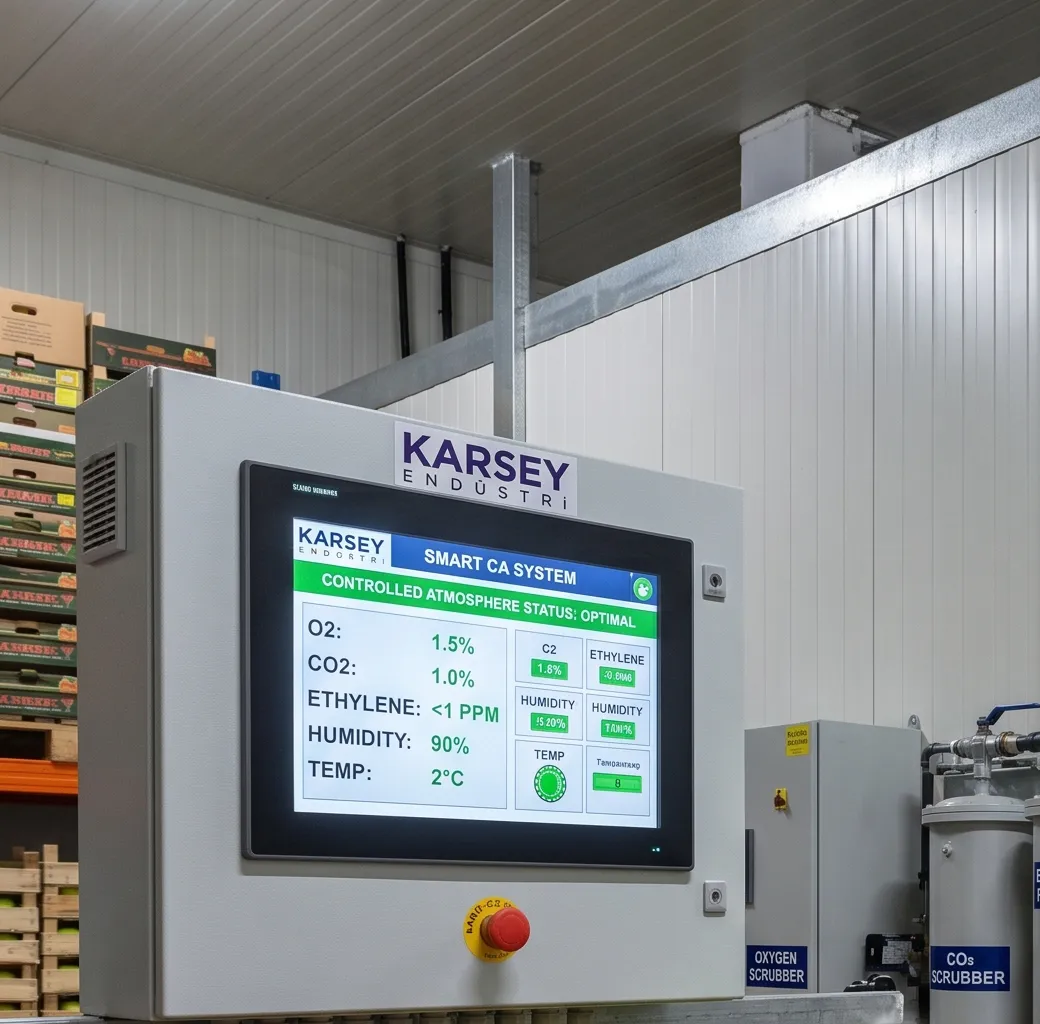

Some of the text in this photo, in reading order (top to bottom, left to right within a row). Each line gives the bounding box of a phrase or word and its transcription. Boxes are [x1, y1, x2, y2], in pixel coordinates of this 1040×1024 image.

[403, 431, 570, 492] KARSEY
[298, 526, 385, 555] KARSEY
[424, 548, 577, 585] SMART CA SYSTEM
[321, 572, 636, 628] CONTROLLED ATMOSPHERE STATUS: OPTIMAL
[307, 618, 341, 639] O2:
[431, 633, 475, 655] 1.5%
[541, 643, 557, 655] C2
[307, 653, 356, 676] CO2:
[590, 649, 645, 666] ETHYLENE
[431, 667, 475, 688] 1.0%
[307, 689, 499, 723] ETHYLENE: <1 PPM
[520, 694, 575, 710] HUMIDITY
[591, 702, 643, 716] HUMIDITY
[308, 724, 470, 755] HUMIDITY: 90%
[534, 749, 565, 761] TEMP
[307, 760, 464, 787] TEMP: 2°C
[754, 950, 797, 965] OXYGEN
[749, 967, 805, 983] SCRUBBER
[931, 969, 1006, 985] SCRUBBER
